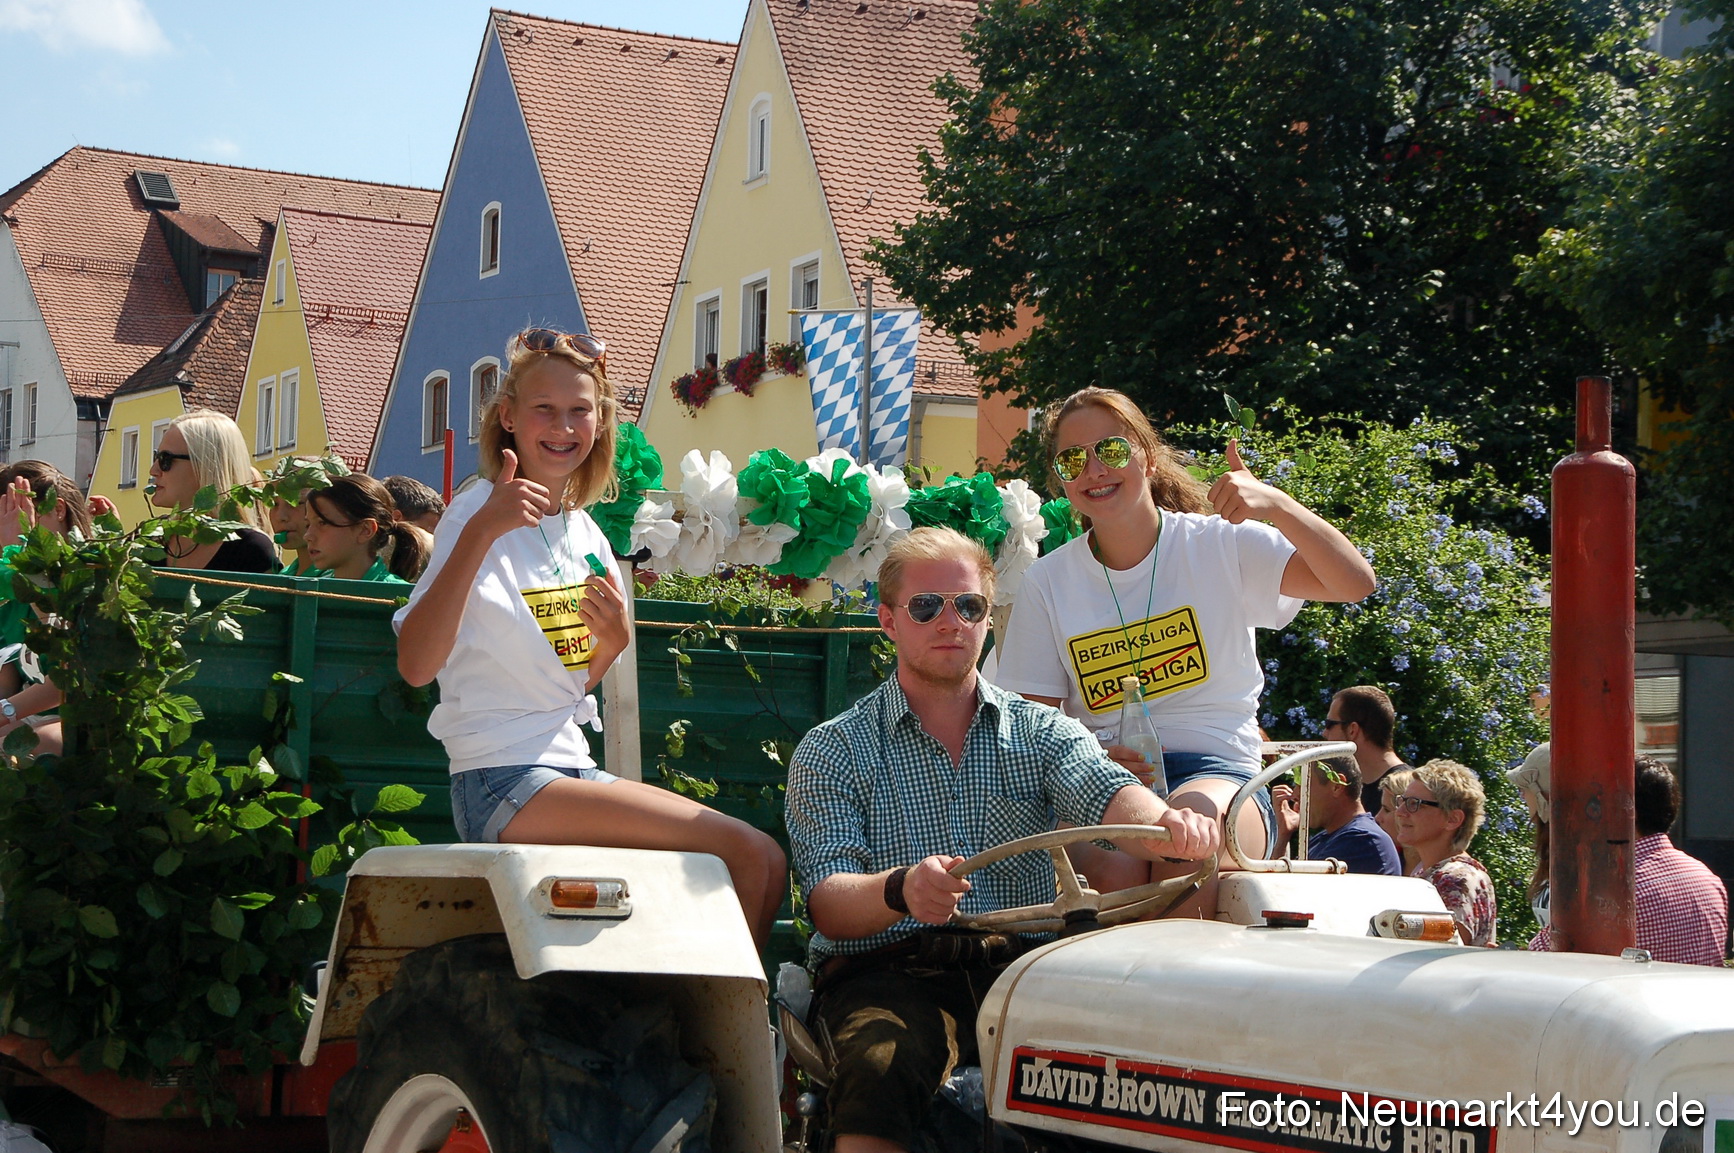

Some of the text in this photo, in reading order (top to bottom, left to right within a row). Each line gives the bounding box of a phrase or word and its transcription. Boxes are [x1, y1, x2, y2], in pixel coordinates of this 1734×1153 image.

[1078, 621, 1191, 663] BEZIRKSLIGA
[1088, 655, 1200, 700] KRESLIGA
[1021, 1063, 1098, 1106] DAVID
[1101, 1075, 1205, 1123] BROWN
